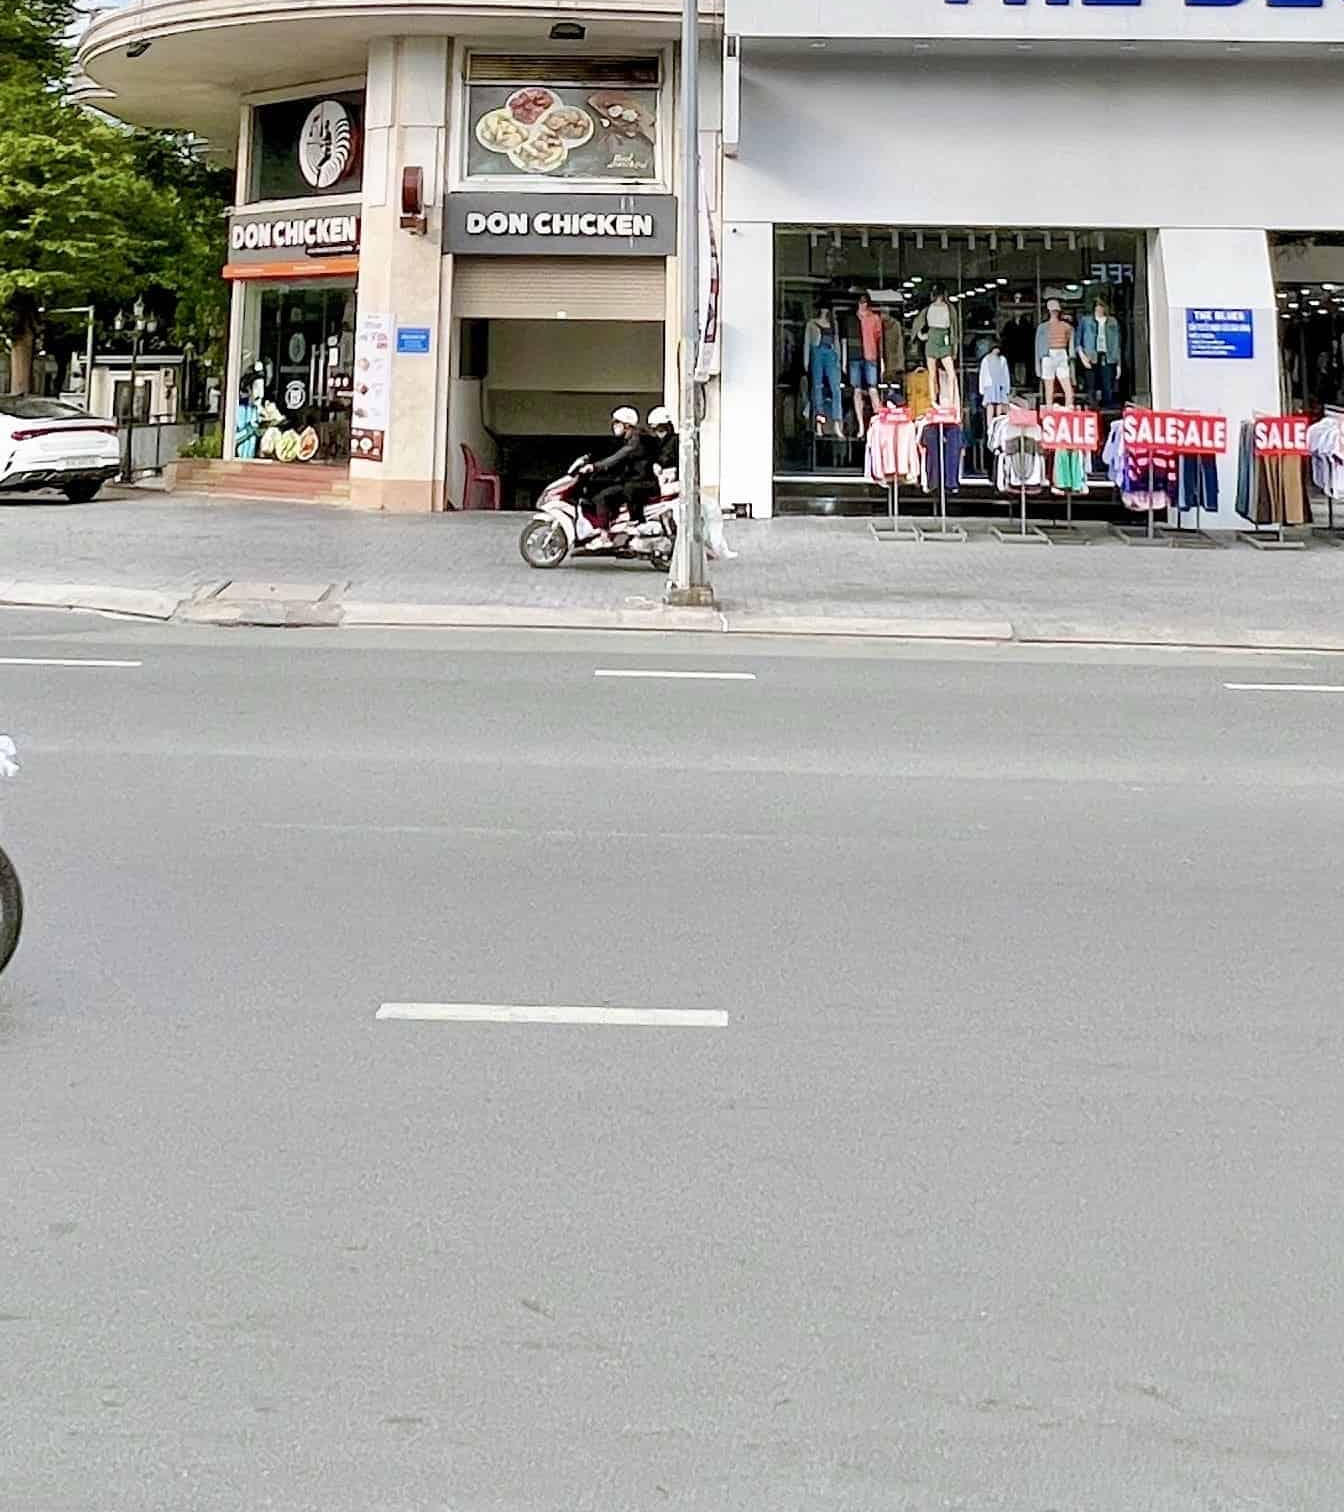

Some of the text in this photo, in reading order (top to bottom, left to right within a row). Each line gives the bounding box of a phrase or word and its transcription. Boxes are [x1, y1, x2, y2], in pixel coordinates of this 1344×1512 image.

[231, 215, 357, 250] DON CHICKEN
[467, 212, 653, 236] DON CHICKEN
[1042, 415, 1097, 445] SALE
[1123, 414, 1178, 445] SALE
[1256, 420, 1306, 450] SALE
